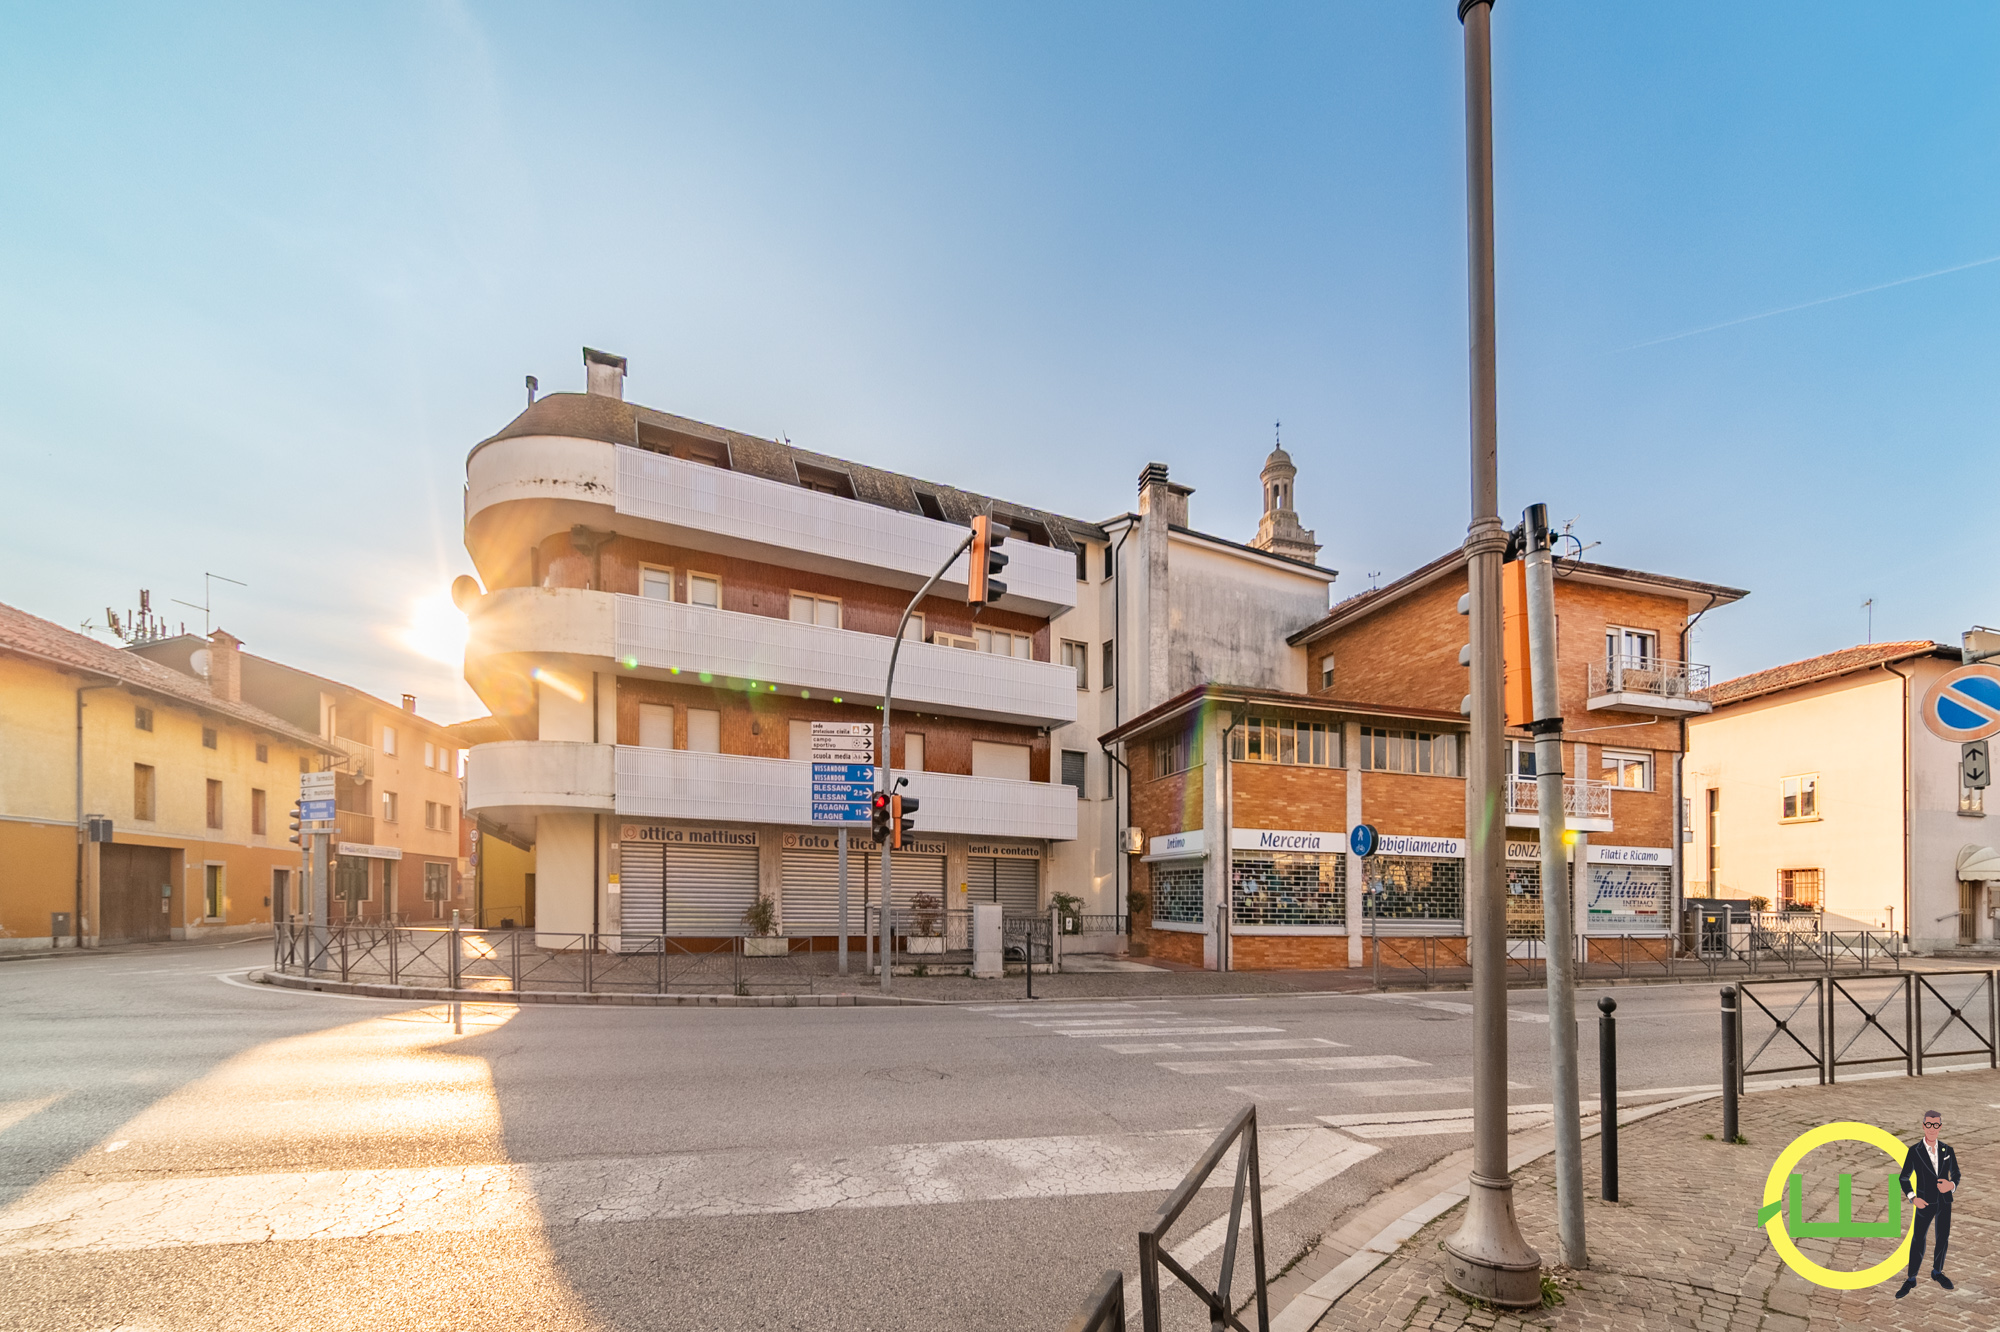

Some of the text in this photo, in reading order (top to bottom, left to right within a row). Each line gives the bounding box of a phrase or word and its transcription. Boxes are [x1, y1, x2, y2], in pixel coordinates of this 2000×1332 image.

[814, 803, 850, 811] FAGAGNA
[640, 827, 756, 845] ottica mattiussi
[799, 834, 829, 848] foto
[834, 837, 877, 850] otica
[1259, 832, 1321, 849] Merceria
[1166, 838, 1186, 850] Intimo
[1377, 836, 1457, 854] bbigliamento
[968, 845, 990, 854] lenti
[1001, 847, 1039, 856] contatto
[1600, 849, 1659, 861] Filati e Ricamo
[1622, 900, 1654, 908] INTIMO
